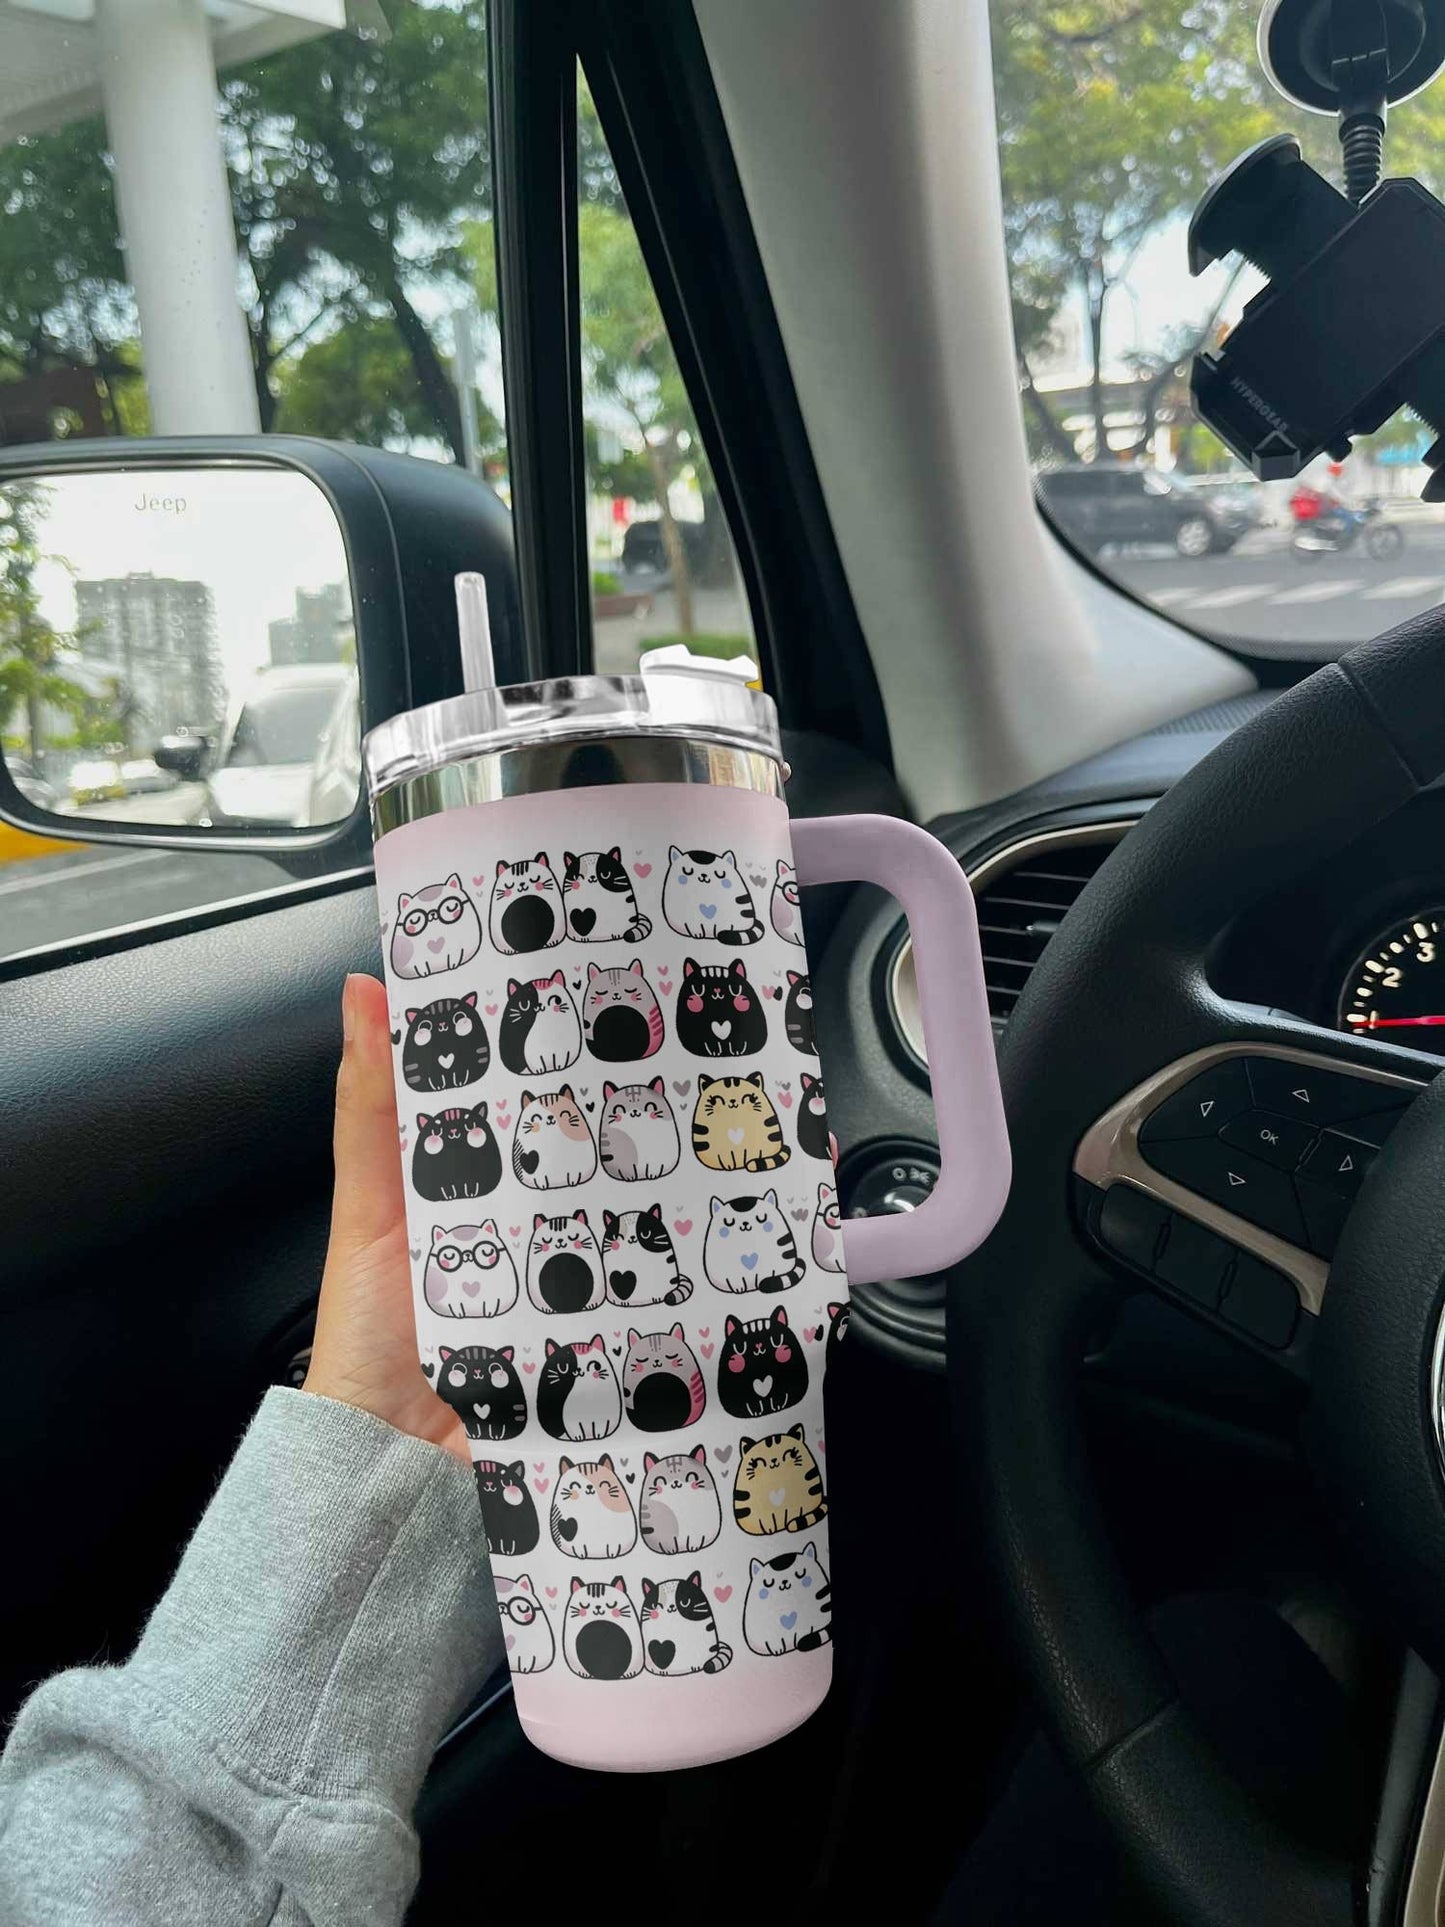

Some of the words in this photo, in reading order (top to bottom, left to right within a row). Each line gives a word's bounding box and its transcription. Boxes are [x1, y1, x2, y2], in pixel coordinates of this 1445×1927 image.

[1230, 377, 1288, 432] HYPERGEAR
[134, 492, 187, 515] Jeep
[1416, 941, 1435, 962] 3
[1382, 967, 1402, 988] 2
[1260, 1129, 1279, 1145] OK
